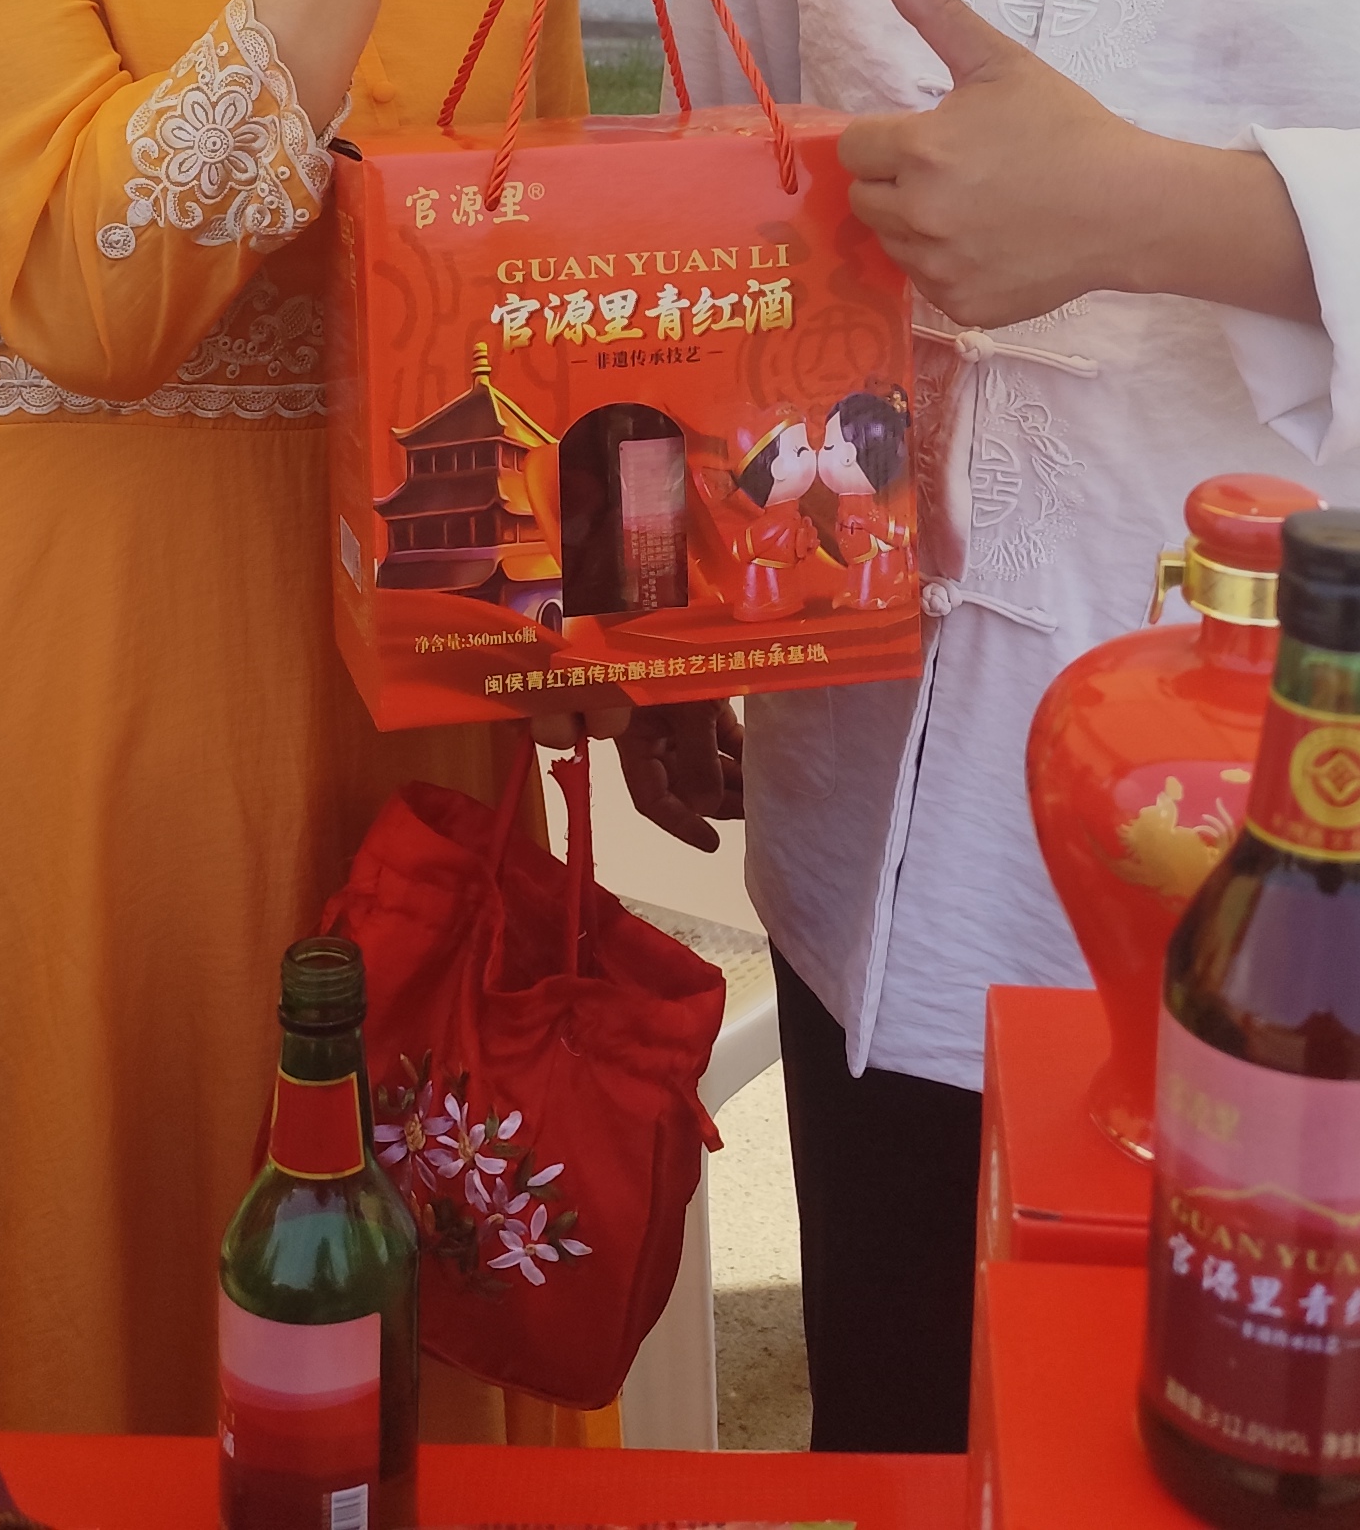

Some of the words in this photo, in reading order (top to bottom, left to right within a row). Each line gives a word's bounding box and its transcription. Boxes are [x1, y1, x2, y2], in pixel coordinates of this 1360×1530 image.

[496, 253, 617, 284] GUAN
[625, 246, 739, 277] YUAN
[748, 243, 791, 269] LI
[490, 277, 793, 352] 官源里青红酒
[484, 642, 830, 696] 闽侯青红酒传统酿造技艺非遗传承基地
[1169, 1195, 1264, 1261] GUAN
